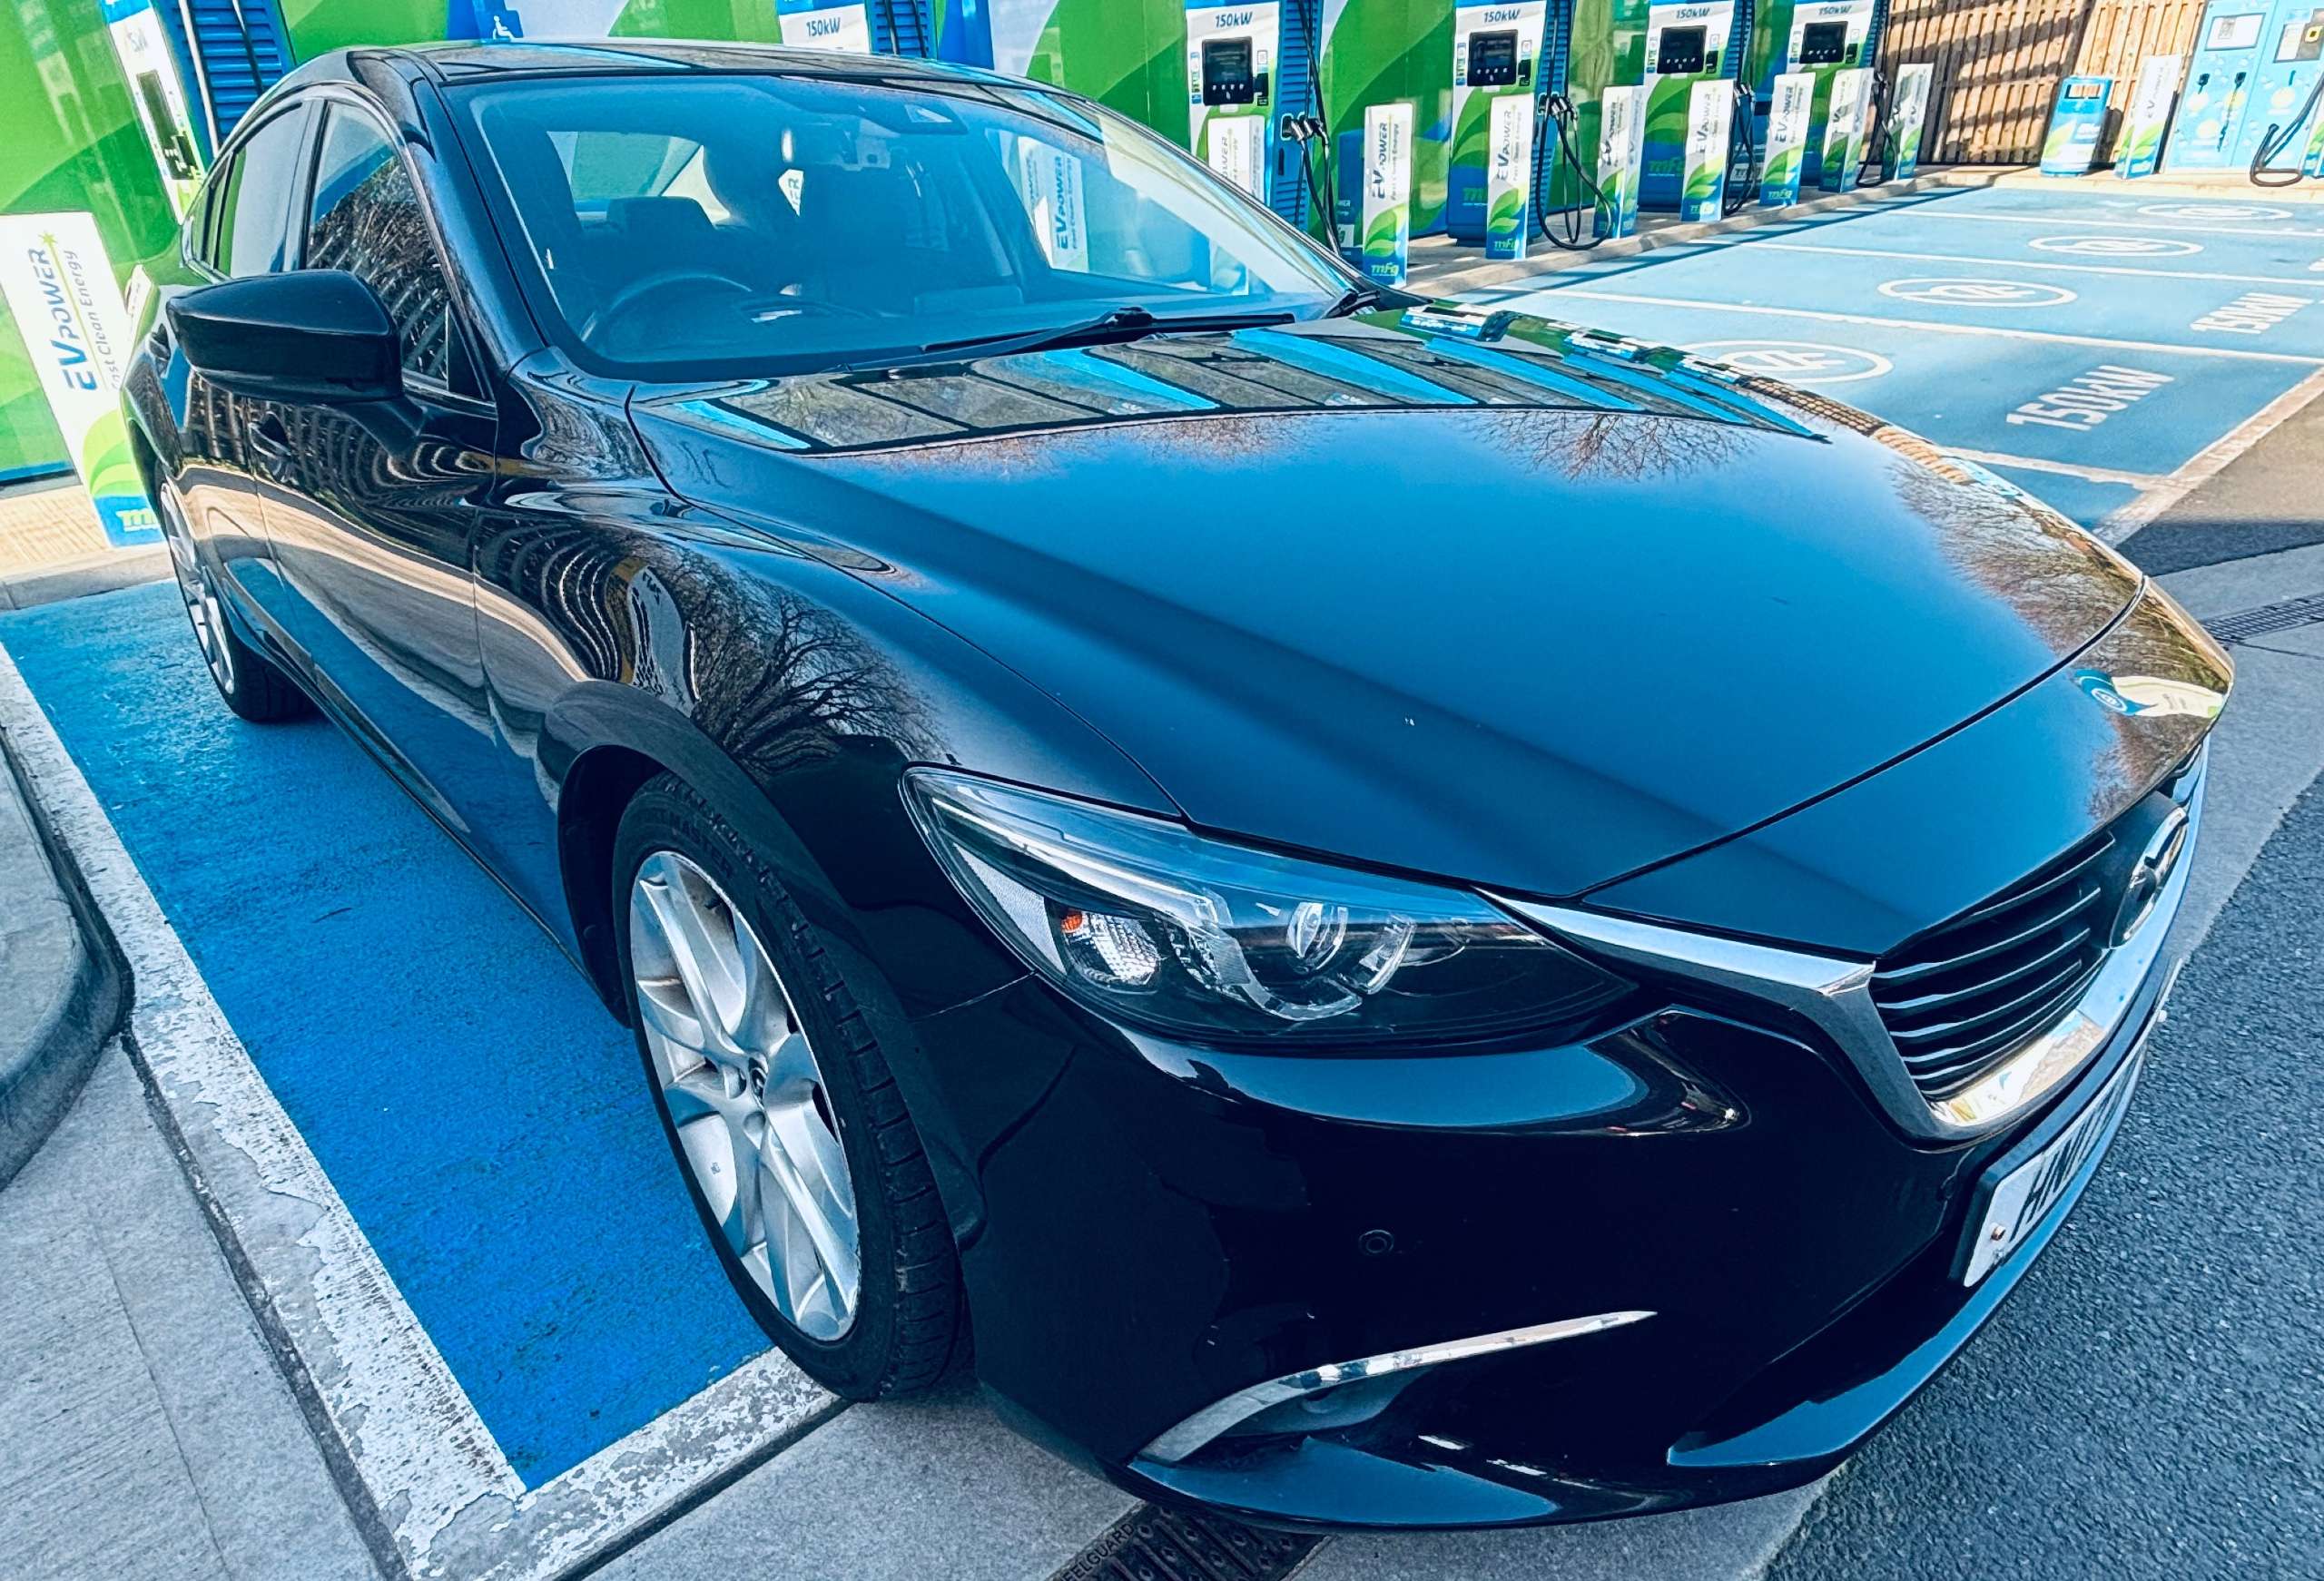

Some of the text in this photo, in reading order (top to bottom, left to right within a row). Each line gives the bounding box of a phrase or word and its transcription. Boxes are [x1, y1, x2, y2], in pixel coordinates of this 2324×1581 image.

[806, 17, 841, 36] 150kW
[1216, 12, 1253, 28] 150kW
[1483, 9, 1521, 23] 150kW
[64, 250, 94, 308] Energy
[89, 311, 112, 356] Clean
[1059, 1522, 1135, 1581] EELGUARD
